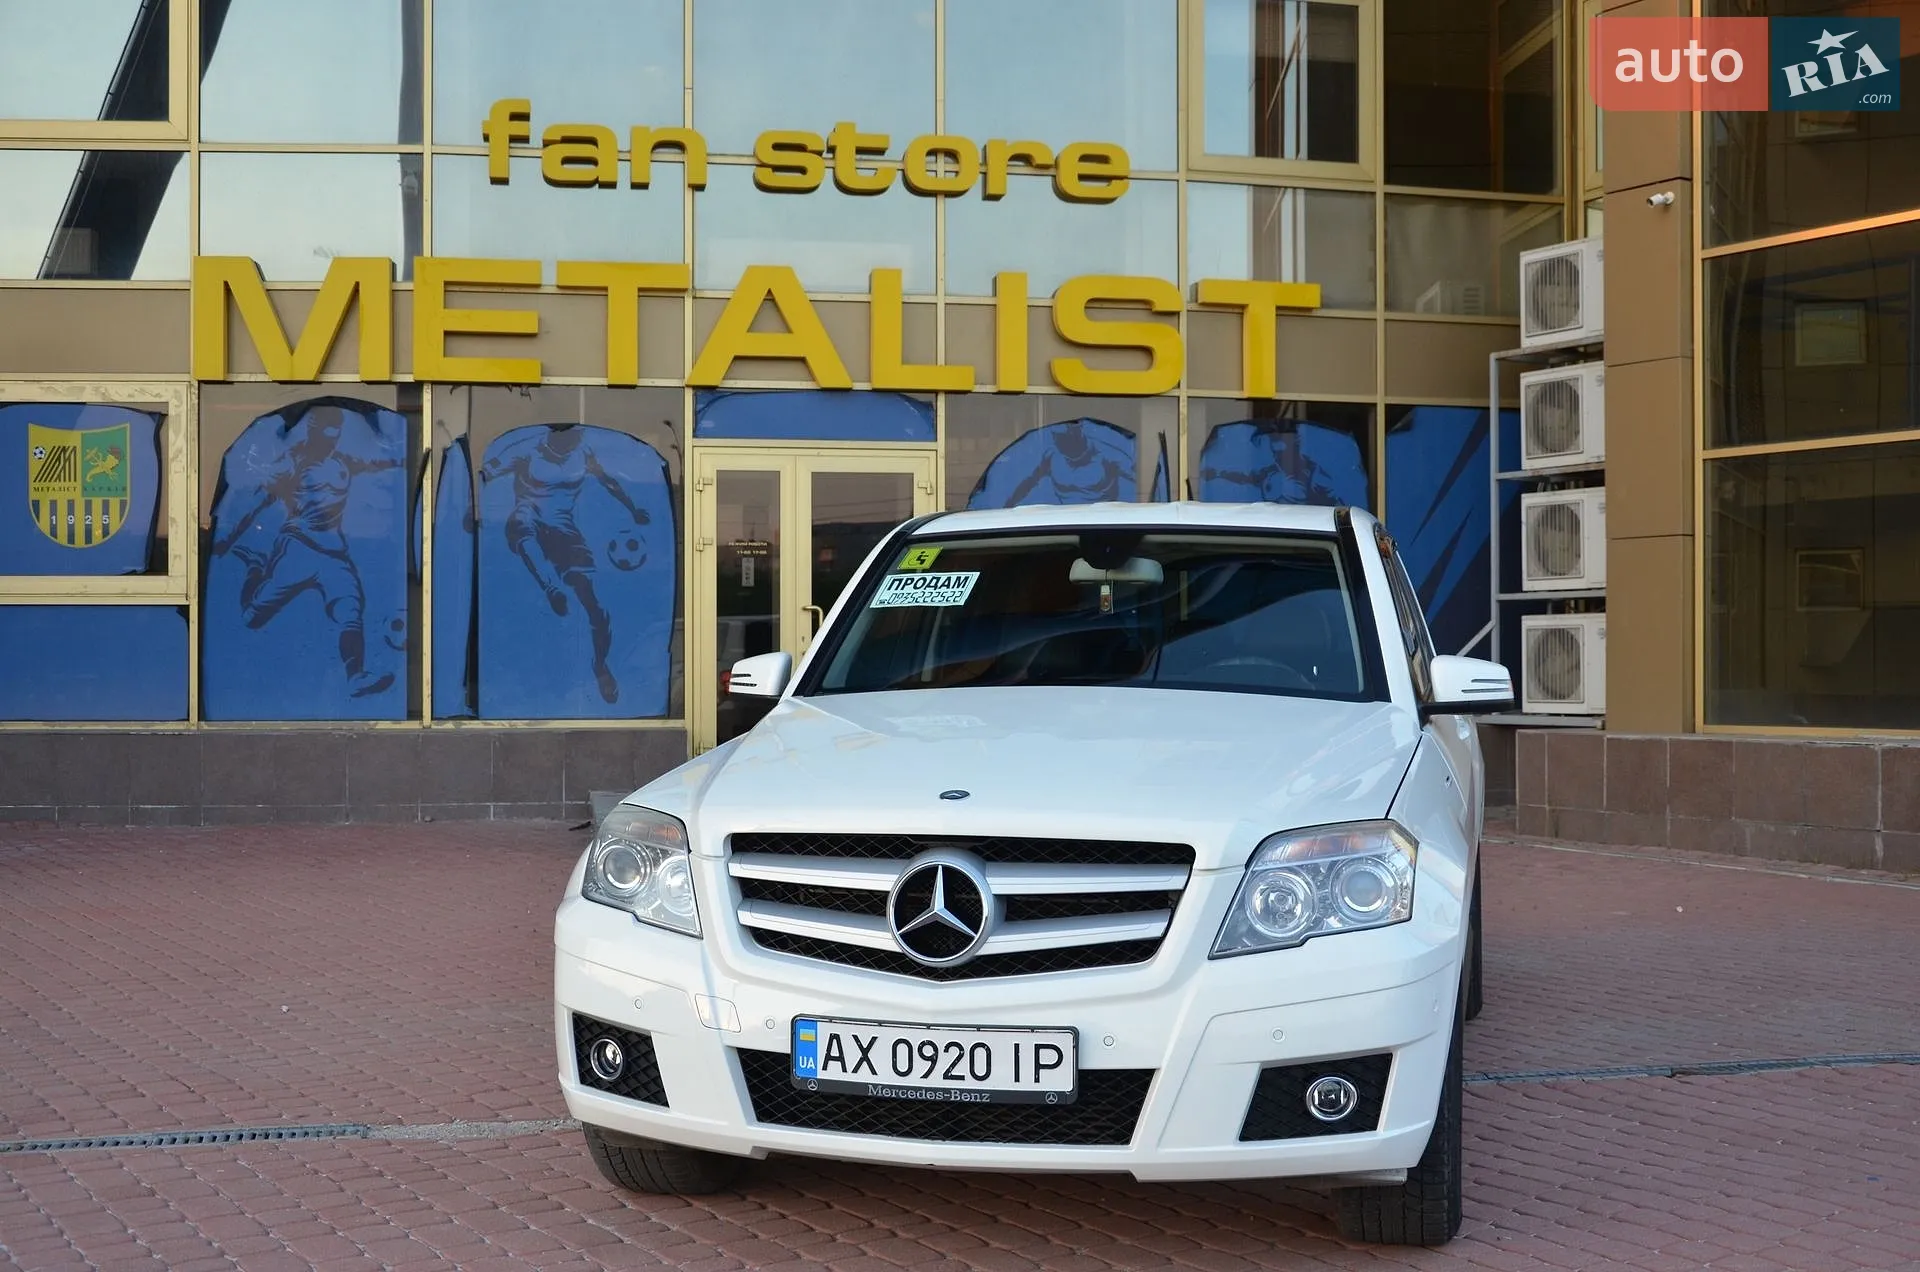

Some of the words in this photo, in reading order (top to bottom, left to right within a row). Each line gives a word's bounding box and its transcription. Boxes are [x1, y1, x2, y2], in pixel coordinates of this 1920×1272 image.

[482, 98, 707, 191] fan
[753, 122, 1130, 204] store
[193, 256, 1321, 399] METALIST
[887, 576, 970, 591] ПРОДАМ
[799, 1056, 816, 1070] UA
[821, 1033, 879, 1076] AX
[891, 1038, 992, 1082] 0920
[1013, 1043, 1064, 1084] IP
[867, 1084, 991, 1103] Mercedes-Benz
